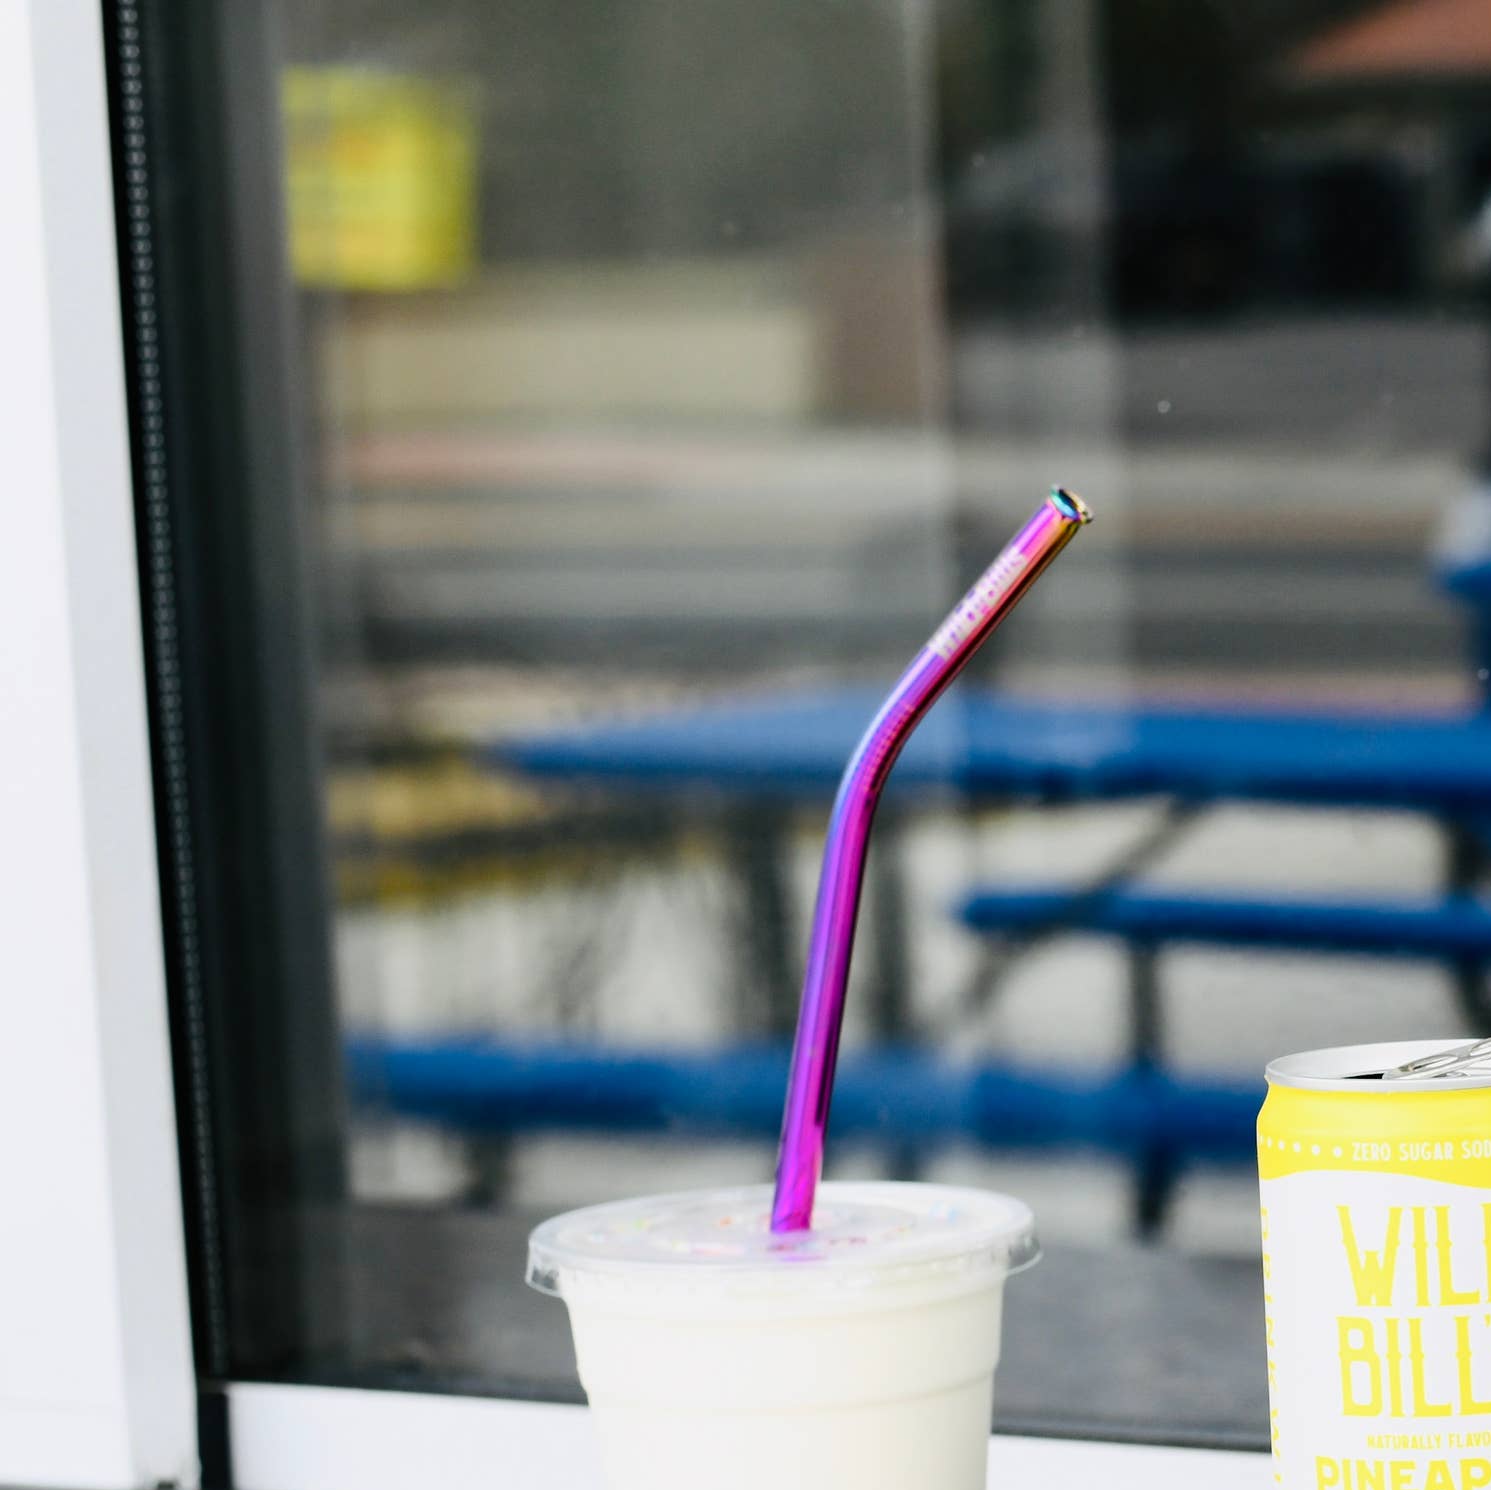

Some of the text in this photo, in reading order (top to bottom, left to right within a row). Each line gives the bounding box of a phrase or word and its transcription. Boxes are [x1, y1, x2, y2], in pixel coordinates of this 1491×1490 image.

[1352, 1143, 1391, 1161] ZERO
[1400, 1142, 1453, 1161] SUGAR
[1367, 1434, 1442, 1449] NATURALLY
